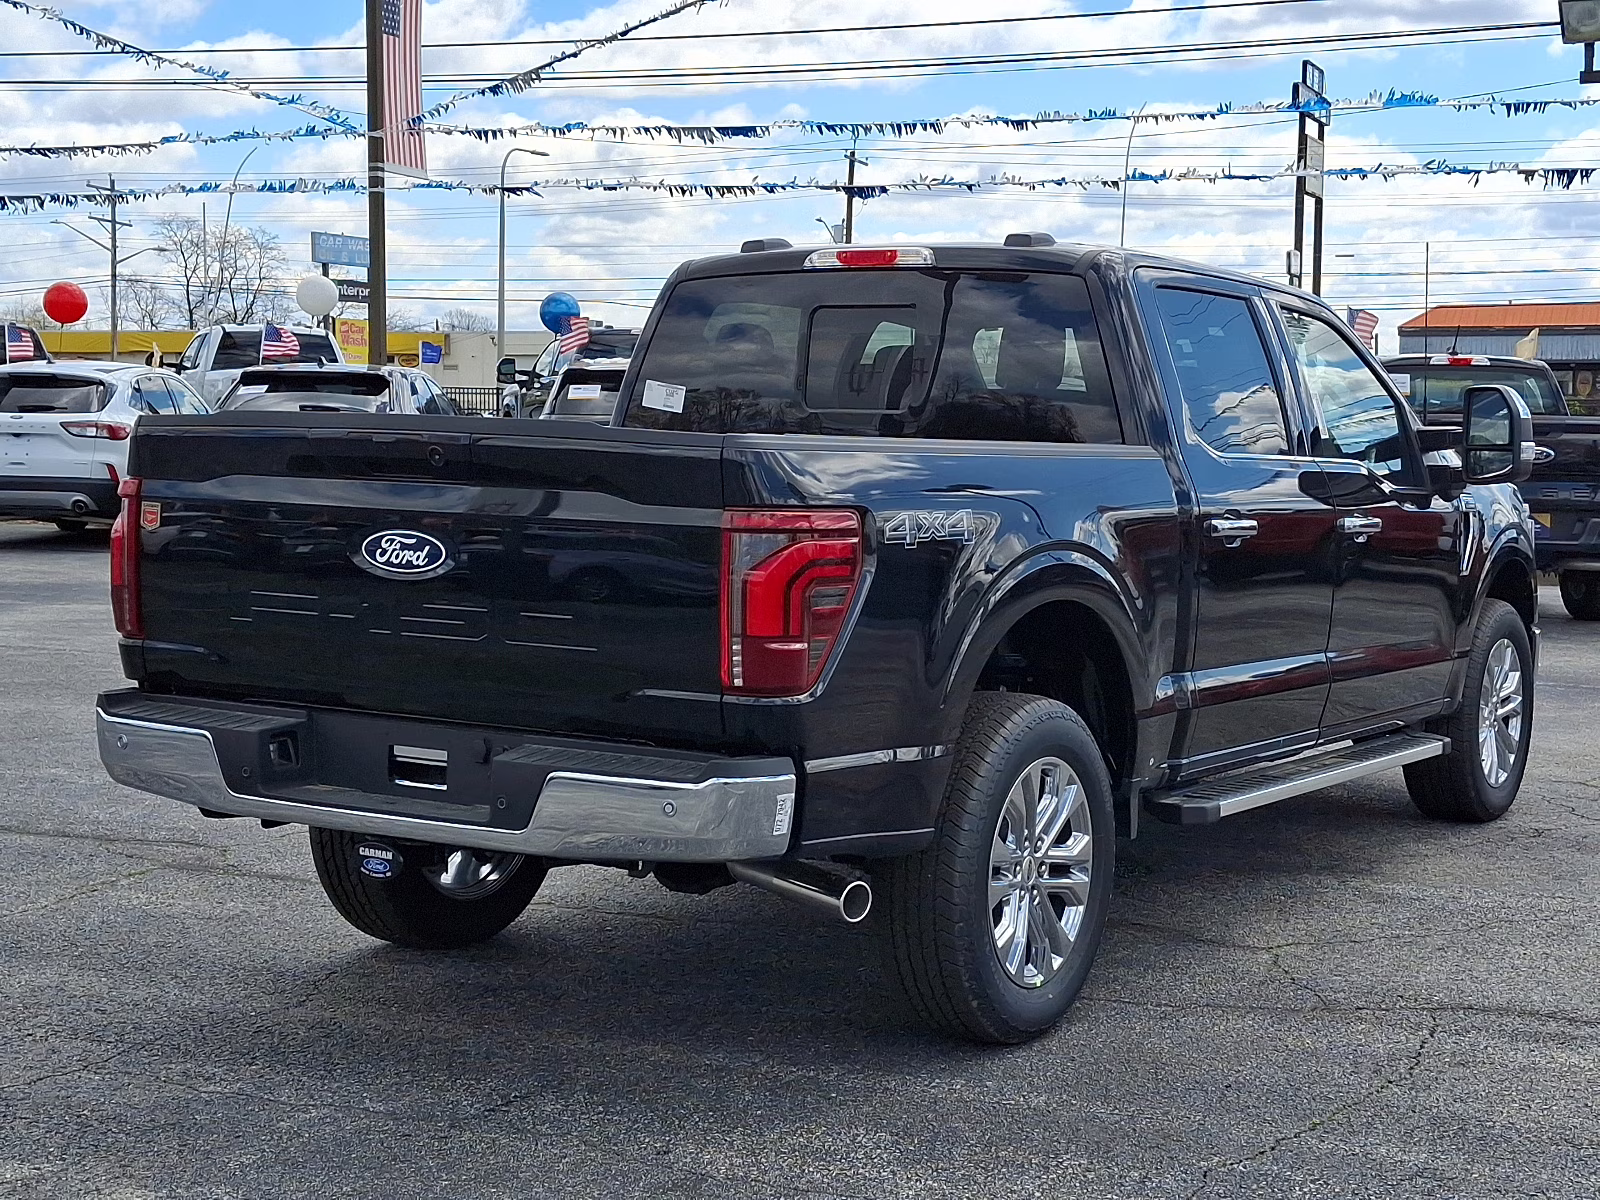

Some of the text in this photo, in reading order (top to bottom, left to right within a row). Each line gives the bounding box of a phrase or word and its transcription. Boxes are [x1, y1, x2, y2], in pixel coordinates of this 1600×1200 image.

[320, 235, 369, 251] CAR WAS
[342, 251, 349, 263] &
[355, 252, 368, 264] LU
[337, 284, 370, 300] nterpr
[349, 323, 366, 334] Car
[341, 334, 368, 347] Wash
[375, 535, 431, 566] Ford
[359, 846, 393, 860] CARMAN
